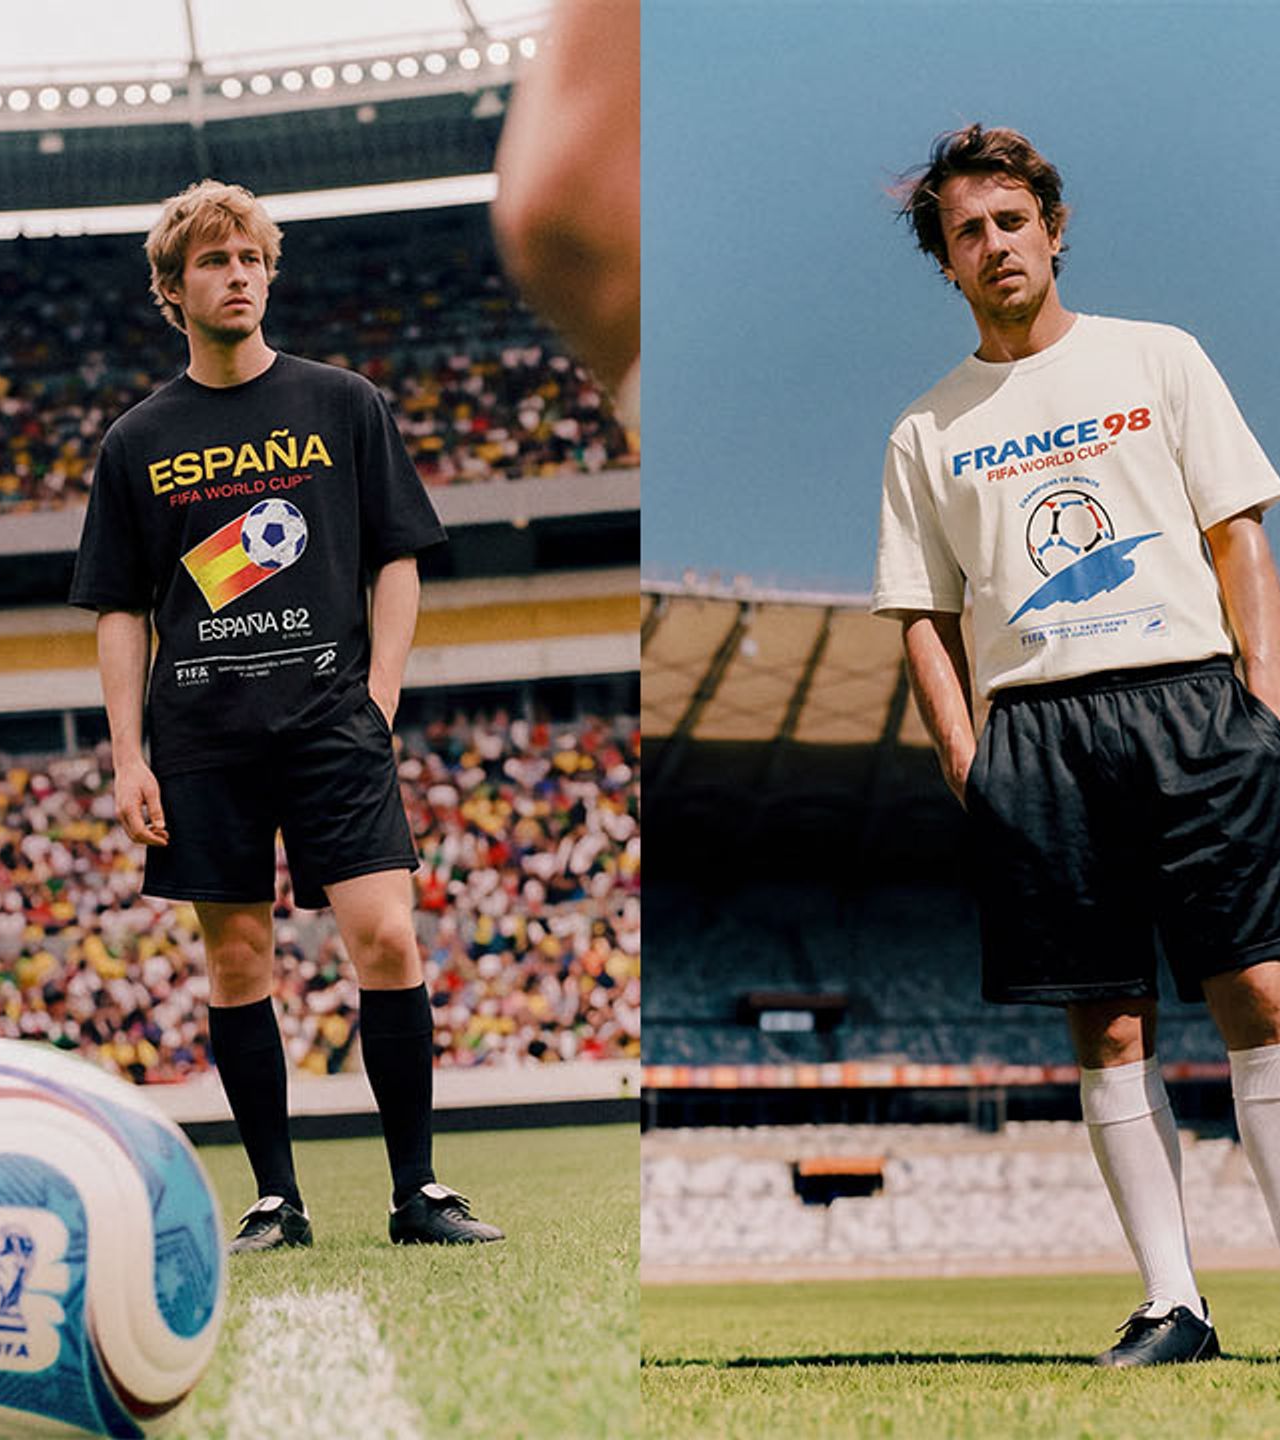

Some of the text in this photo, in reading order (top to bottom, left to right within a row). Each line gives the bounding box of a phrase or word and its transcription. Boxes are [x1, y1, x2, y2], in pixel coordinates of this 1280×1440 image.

[952, 407, 1152, 477] FRANCE 98
[148, 428, 333, 496] ESPAÑA
[986, 466, 1019, 483] FIFA
[1020, 450, 1075, 474] WORLD
[169, 489, 202, 507] FIFA
[204, 480, 266, 500] WORLD
[198, 608, 311, 642] ESPAÑA 82
[1021, 631, 1047, 647] FIFA
[176, 665, 210, 682] FIFA
